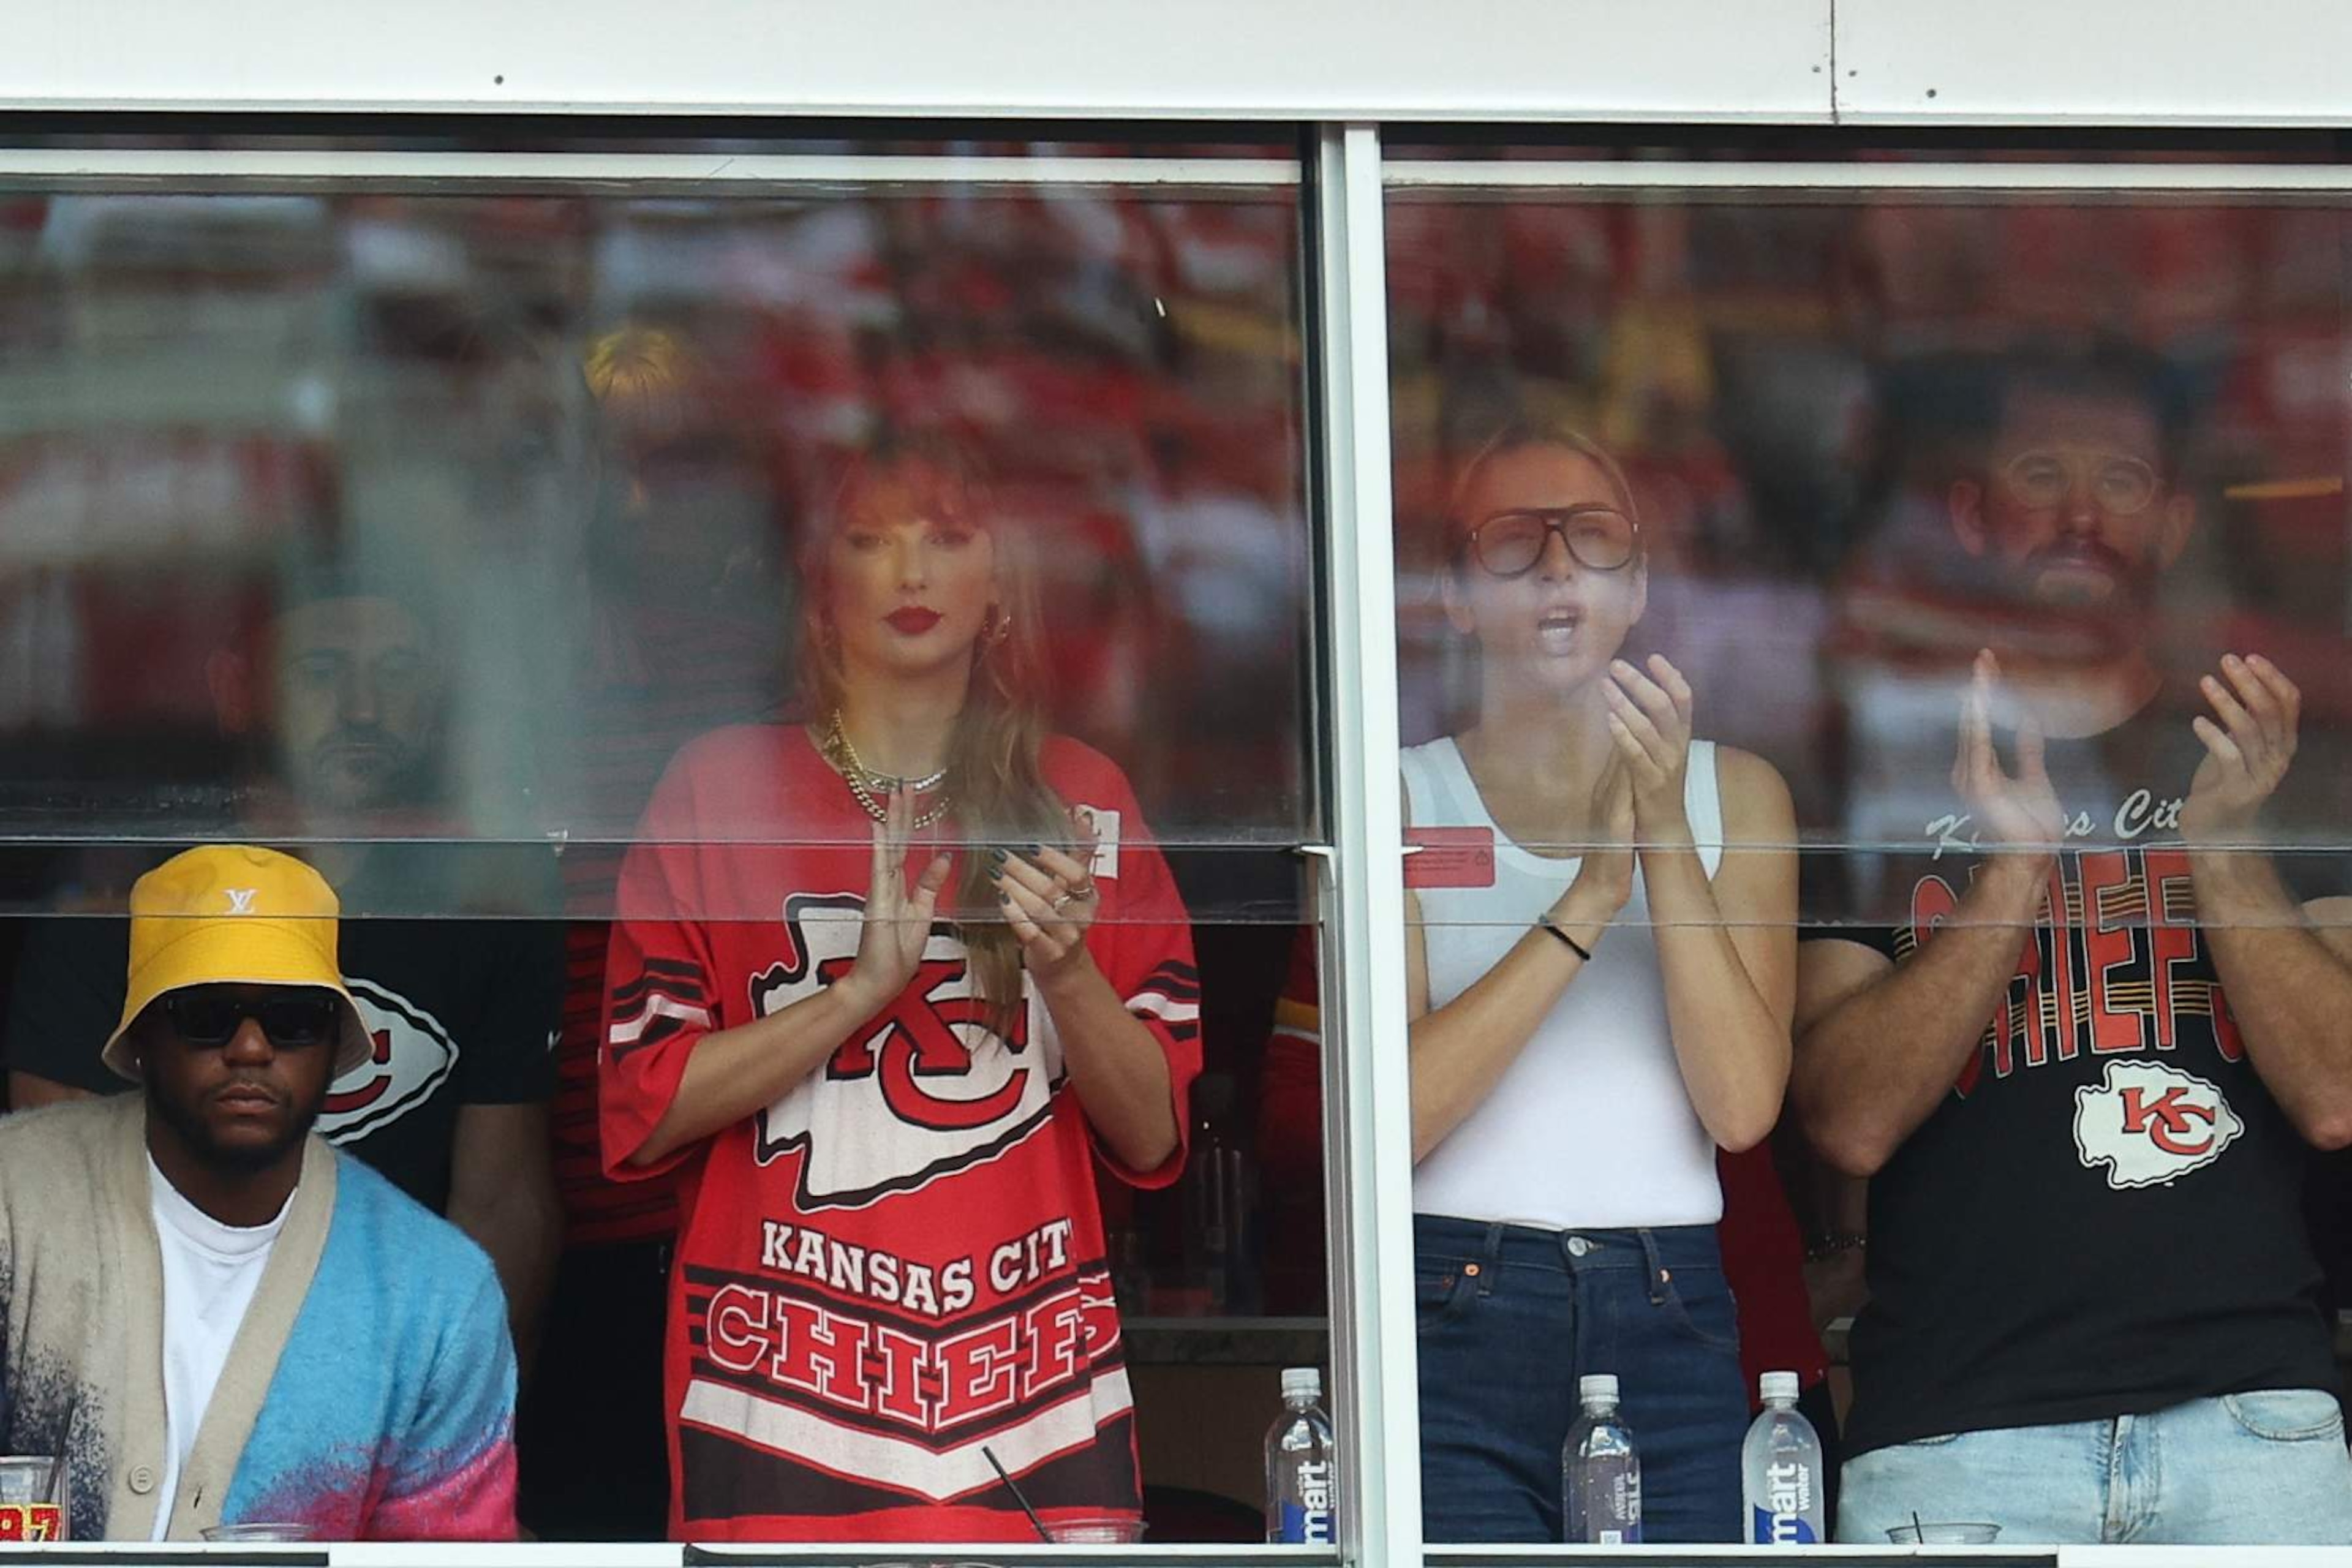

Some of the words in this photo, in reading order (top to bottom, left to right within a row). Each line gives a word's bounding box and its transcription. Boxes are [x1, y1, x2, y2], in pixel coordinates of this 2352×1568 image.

[2114, 788, 2183, 839] Cit
[223, 889, 258, 915] LV
[816, 956, 1030, 1132] KC
[2118, 1086, 2215, 1155] KC
[761, 1219, 976, 1317] KANSAS
[990, 1217, 1077, 1292] CIT
[1297, 1460, 1328, 1544] mart
[1766, 1461, 1798, 1544] mart
[1796, 1462, 1810, 1512] water
